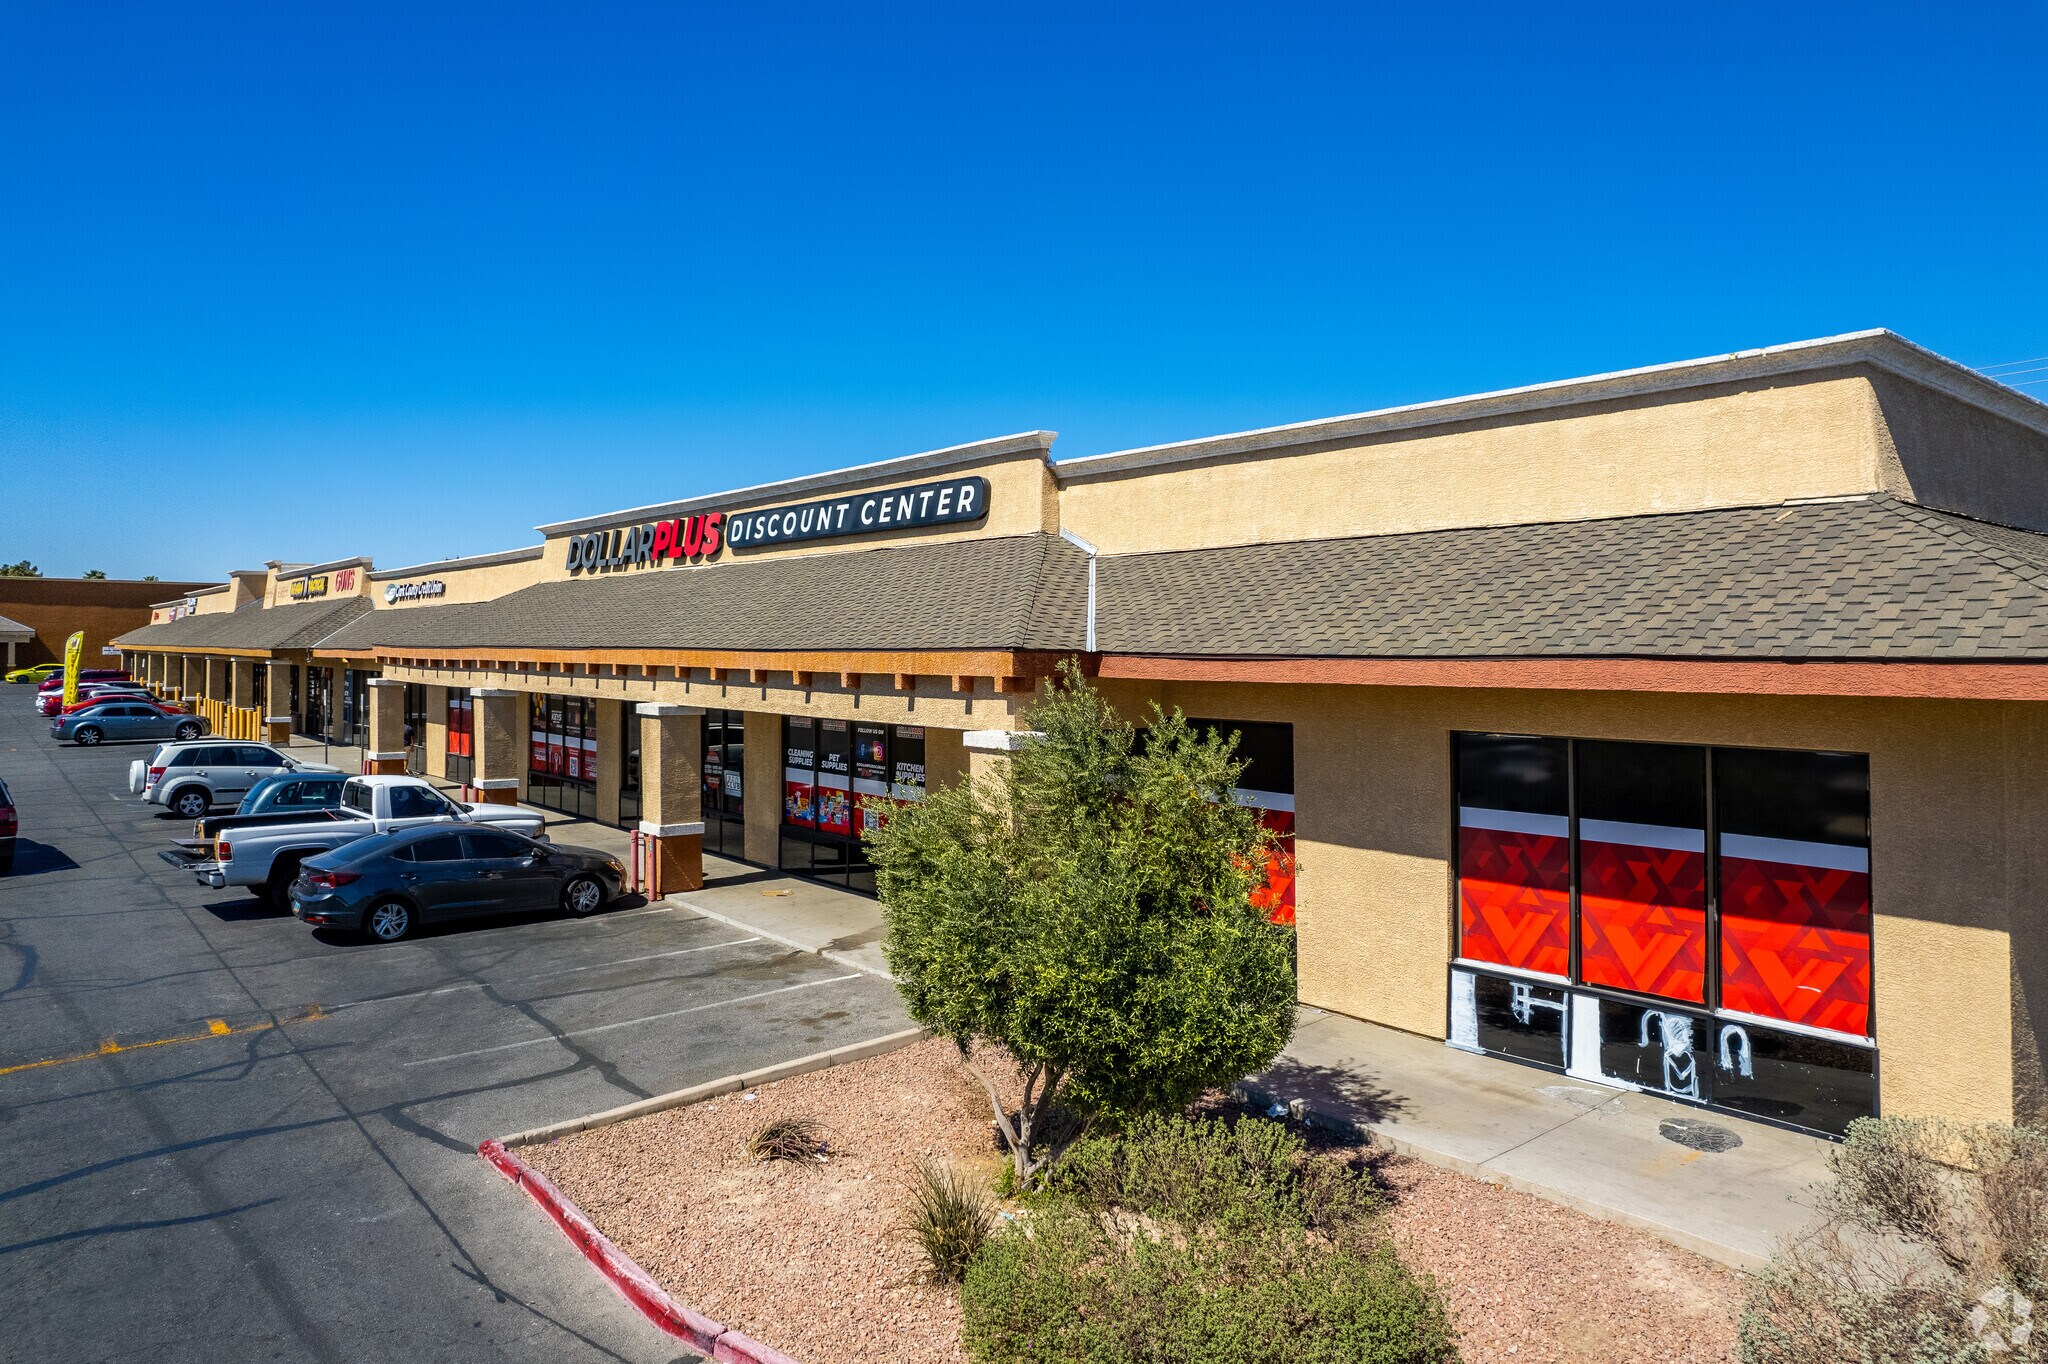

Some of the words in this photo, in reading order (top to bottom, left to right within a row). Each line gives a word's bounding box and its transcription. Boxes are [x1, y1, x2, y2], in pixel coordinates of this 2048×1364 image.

[730, 504, 849, 542] DISCOUNT
[861, 485, 975, 525] CENTER
[566, 512, 723, 570] DOLLARPLUS
[335, 569, 355, 592] GUNS
[788, 748, 814, 758] CLEANING
[829, 754, 840, 762] PET
[788, 757, 812, 766] SUPPLIES
[821, 761, 848, 772] SUPPLIES
[896, 762, 924, 773] KITCHEN
[896, 771, 926, 782] SUPPLIES
